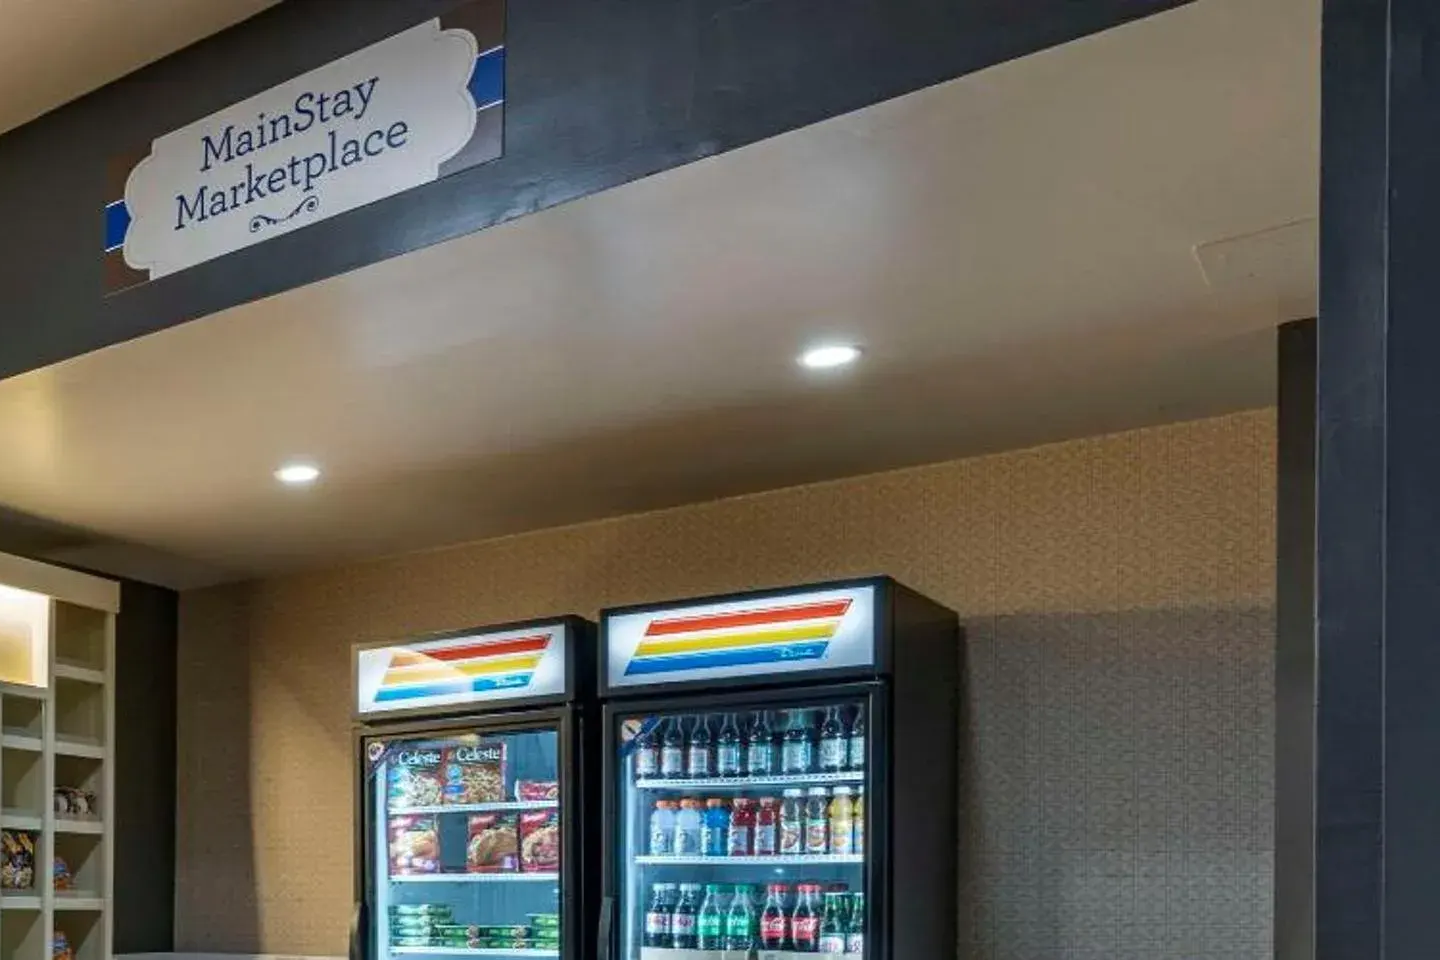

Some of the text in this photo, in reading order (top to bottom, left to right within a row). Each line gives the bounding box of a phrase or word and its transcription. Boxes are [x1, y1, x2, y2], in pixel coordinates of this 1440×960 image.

[199, 75, 380, 173] MainStay
[173, 120, 409, 231] Marketplace
[456, 747, 501, 761] Celeste
